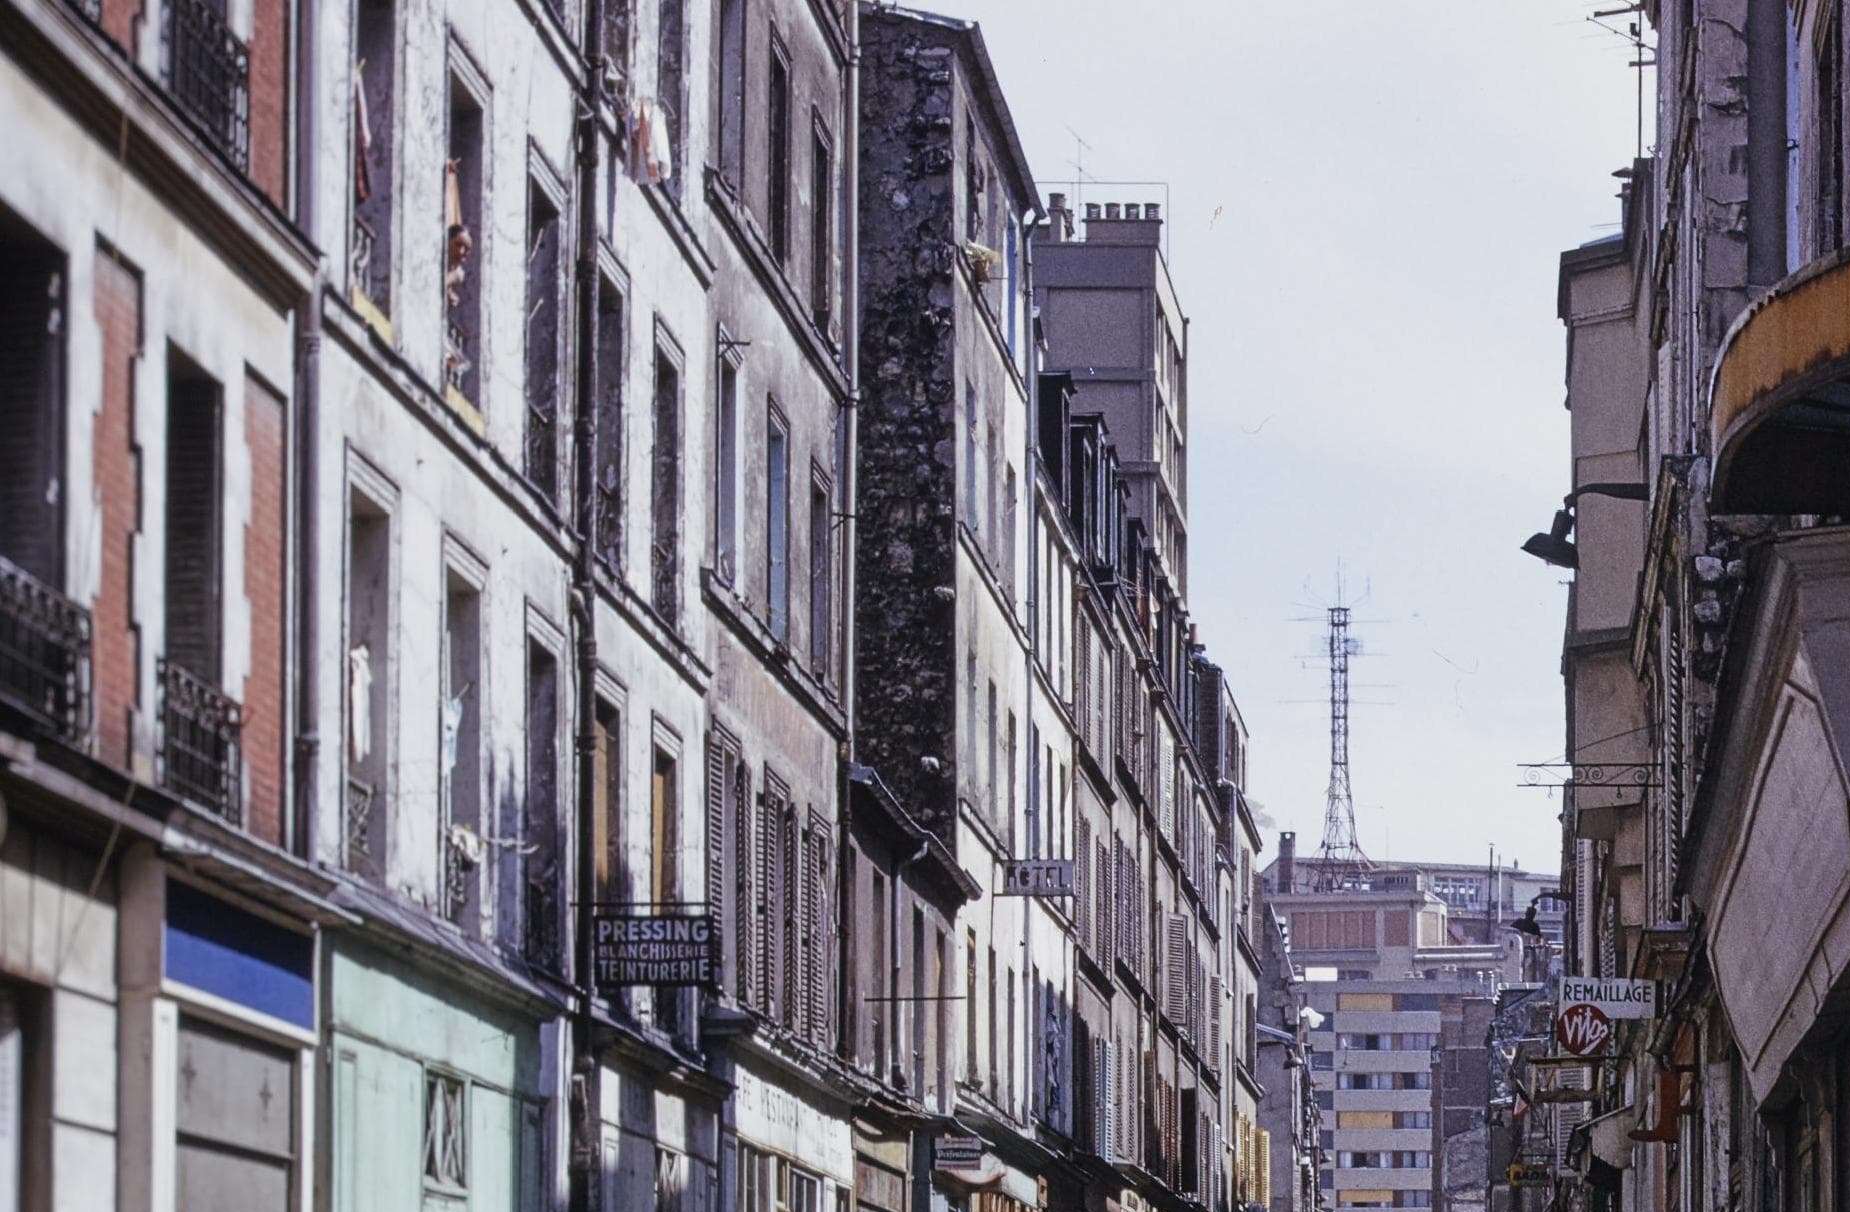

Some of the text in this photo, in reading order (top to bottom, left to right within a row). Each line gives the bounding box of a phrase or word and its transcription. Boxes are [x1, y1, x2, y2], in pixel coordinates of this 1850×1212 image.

[598, 919, 710, 943] PRESSING
[598, 943, 710, 960] BLANCHISSERIE
[599, 958, 710, 981] TEINTURERIE
[1563, 983, 1652, 1003] REMAILLAGE
